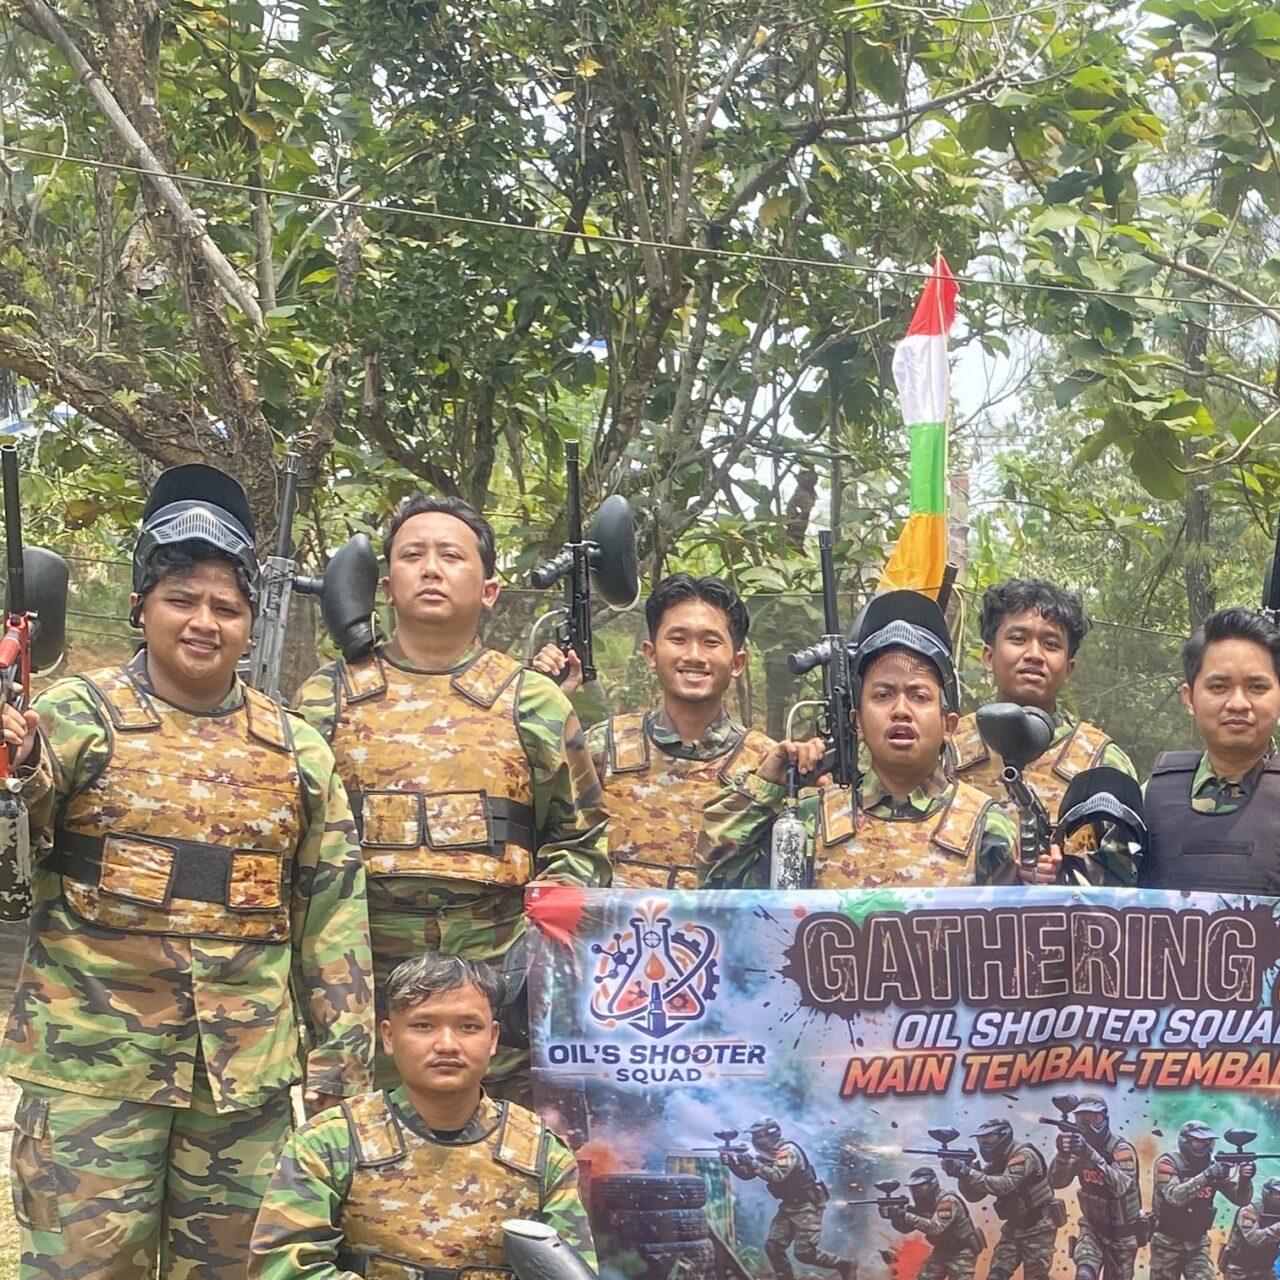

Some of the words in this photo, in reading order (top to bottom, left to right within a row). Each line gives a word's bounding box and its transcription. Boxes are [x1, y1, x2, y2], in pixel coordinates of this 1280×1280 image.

[803, 912, 1257, 1003] GATHERING
[897, 1014, 961, 1050] OIL
[971, 1004, 1157, 1048] SHOOTER
[549, 1044, 621, 1065] OIL'S
[629, 1044, 766, 1065] SHOOTER
[616, 1068, 703, 1084] SQUAD
[842, 1055, 953, 1096] MAIN
